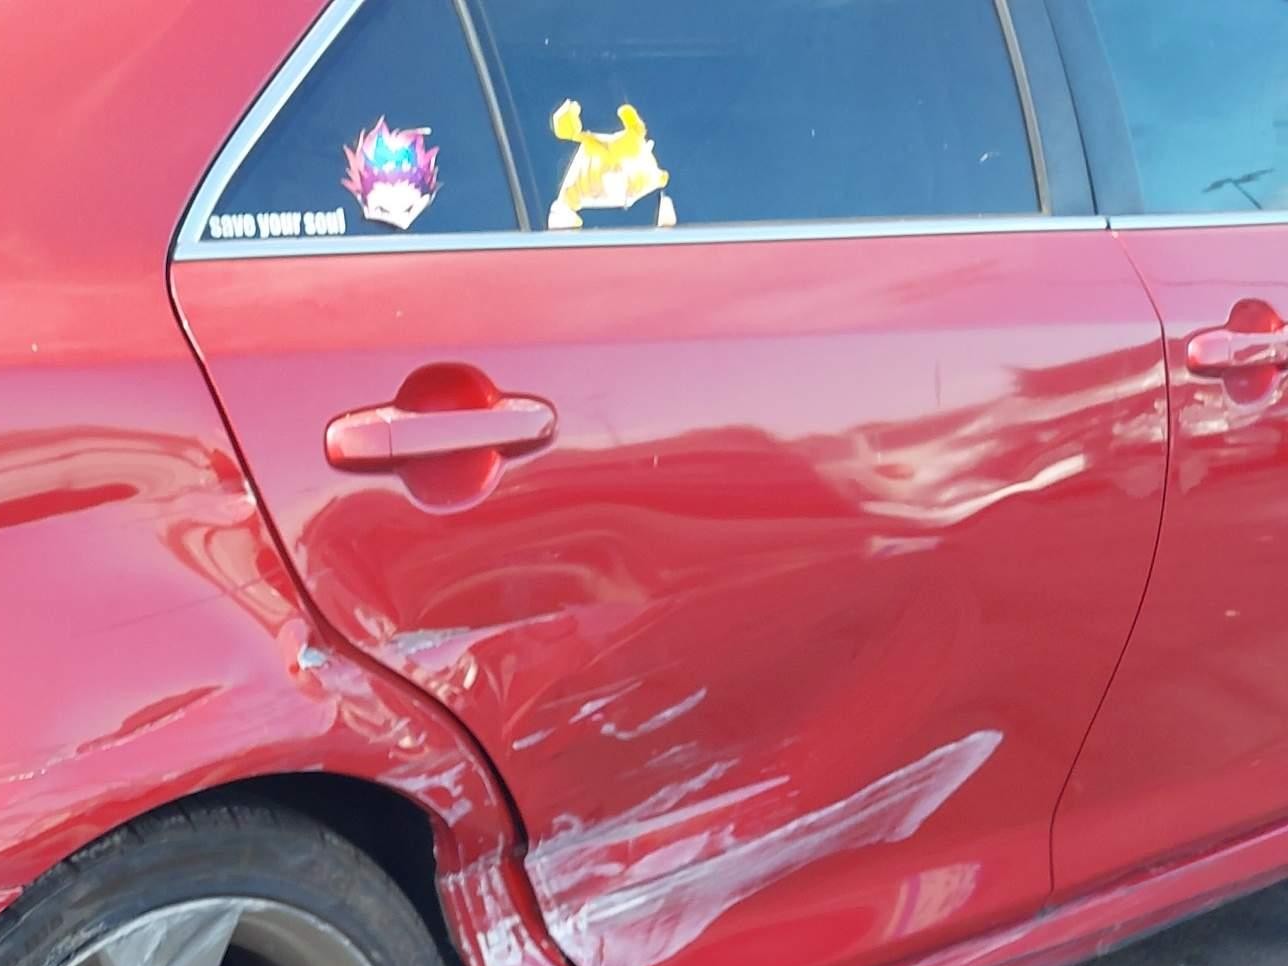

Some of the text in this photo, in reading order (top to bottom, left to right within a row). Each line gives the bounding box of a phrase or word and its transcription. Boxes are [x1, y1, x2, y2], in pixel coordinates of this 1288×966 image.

[209, 206, 346, 240] save your soul
